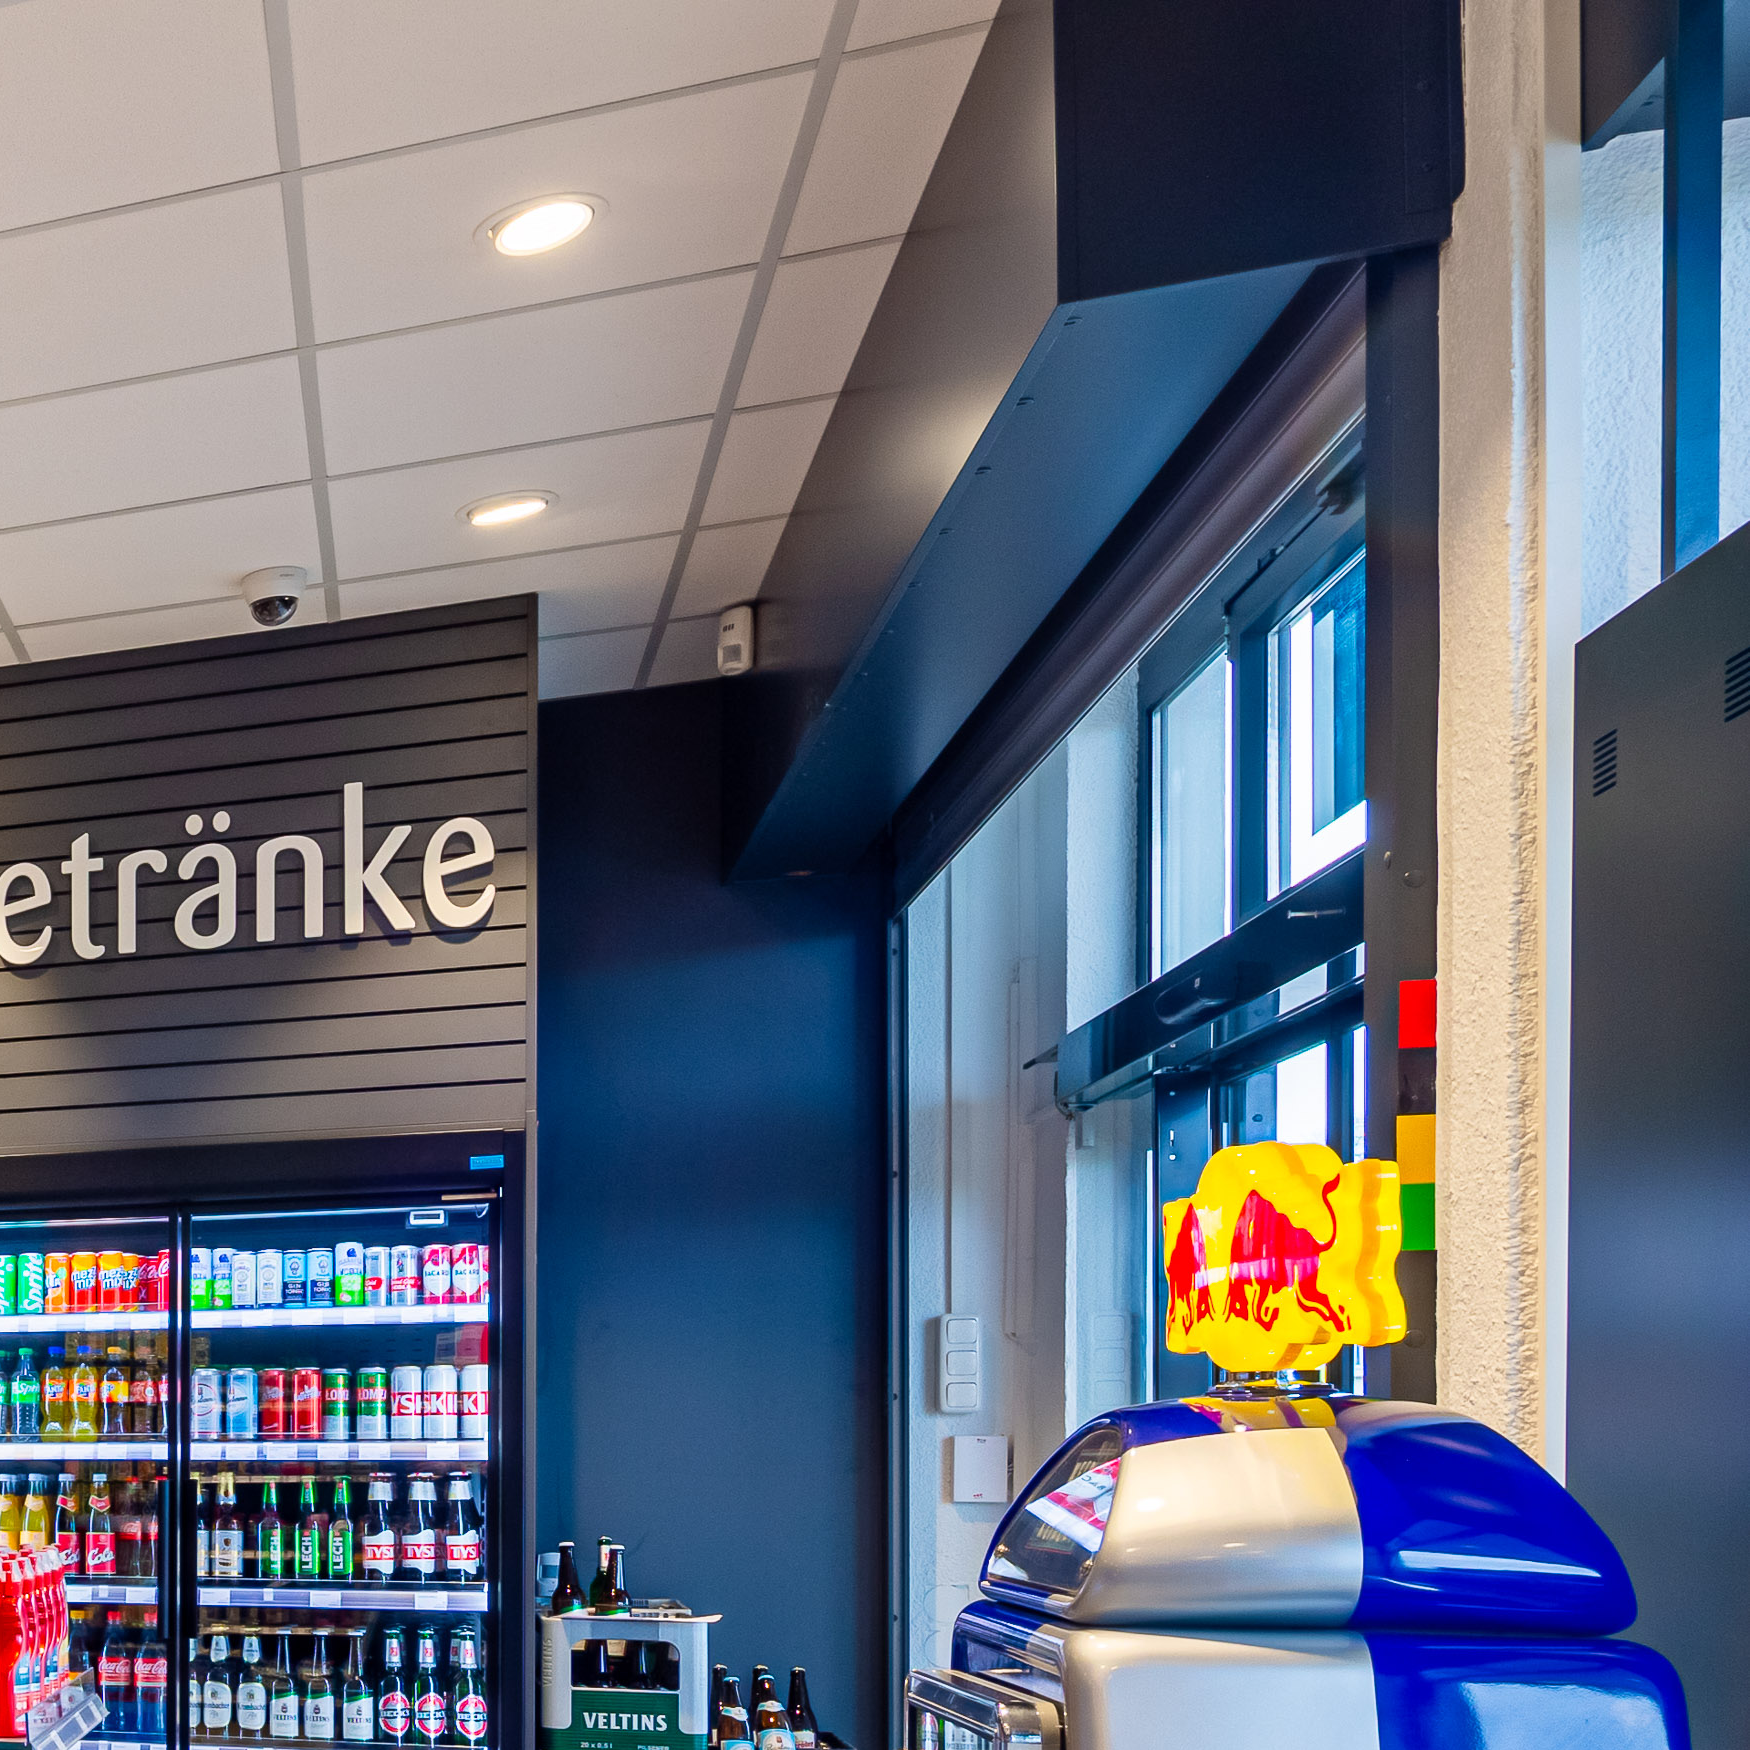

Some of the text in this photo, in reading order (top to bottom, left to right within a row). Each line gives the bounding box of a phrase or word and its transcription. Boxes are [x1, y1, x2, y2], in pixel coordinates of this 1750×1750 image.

[88, 1549, 115, 1565] Cola
[302, 1536, 312, 1569] LECH
[333, 1537, 343, 1570] LECH
[583, 1712, 668, 1733] VELTINS
